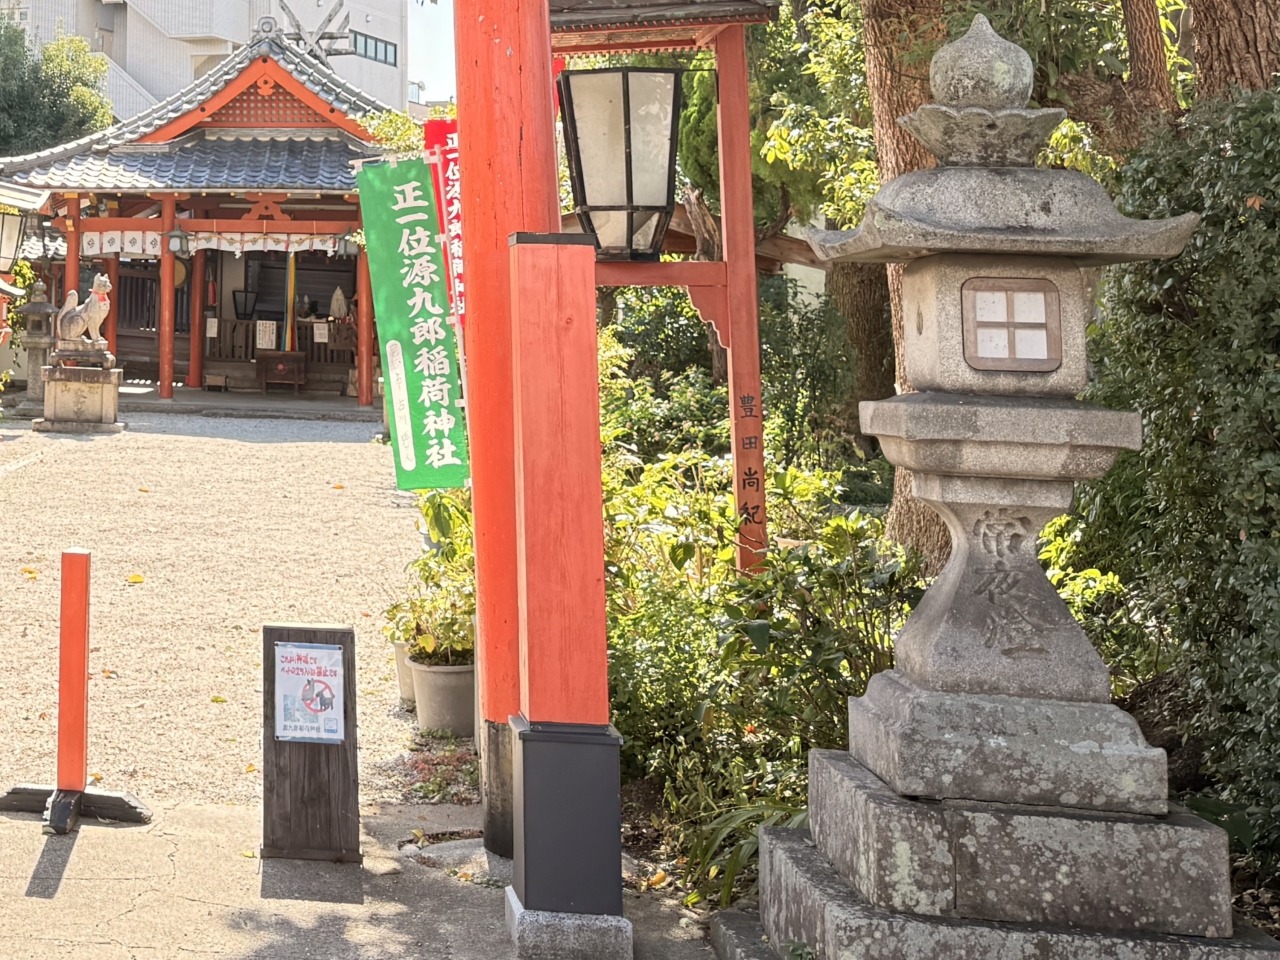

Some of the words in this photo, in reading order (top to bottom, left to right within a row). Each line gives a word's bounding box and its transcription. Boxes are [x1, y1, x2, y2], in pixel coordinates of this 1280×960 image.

[391, 180, 462, 470] 正一位源九郎稲荷神社
[739, 393, 764, 526] 豊田尚紀
